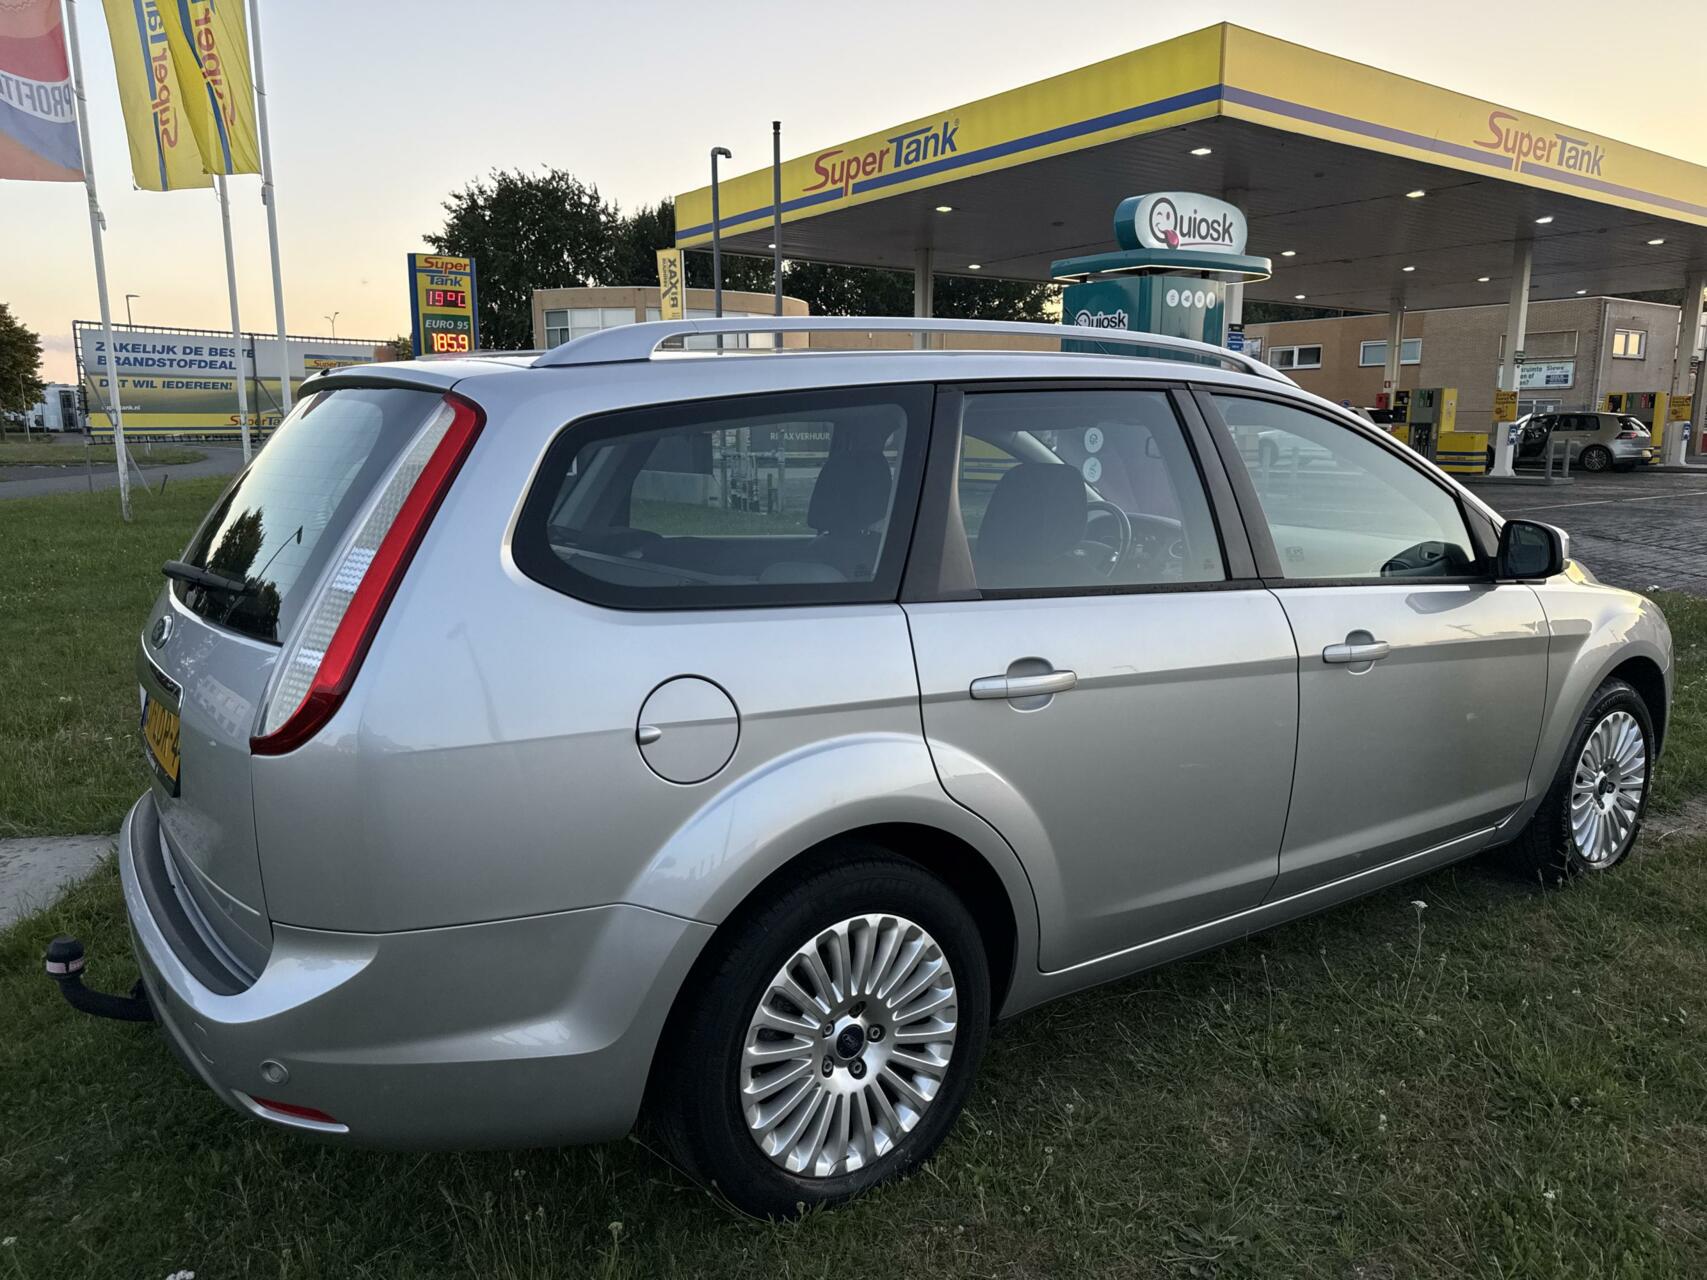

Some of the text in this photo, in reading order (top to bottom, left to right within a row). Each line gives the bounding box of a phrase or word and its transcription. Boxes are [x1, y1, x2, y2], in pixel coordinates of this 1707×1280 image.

[1149, 197, 1234, 247] Quiosk
[423, 256, 469, 275] Super
[425, 273, 463, 287] Tank
[425, 319, 469, 330] EURO 95
[182, 345, 204, 356] DE
[99, 379, 233, 391] DT WIL IEDEREEN!
[770, 432, 794, 440] RIAX
